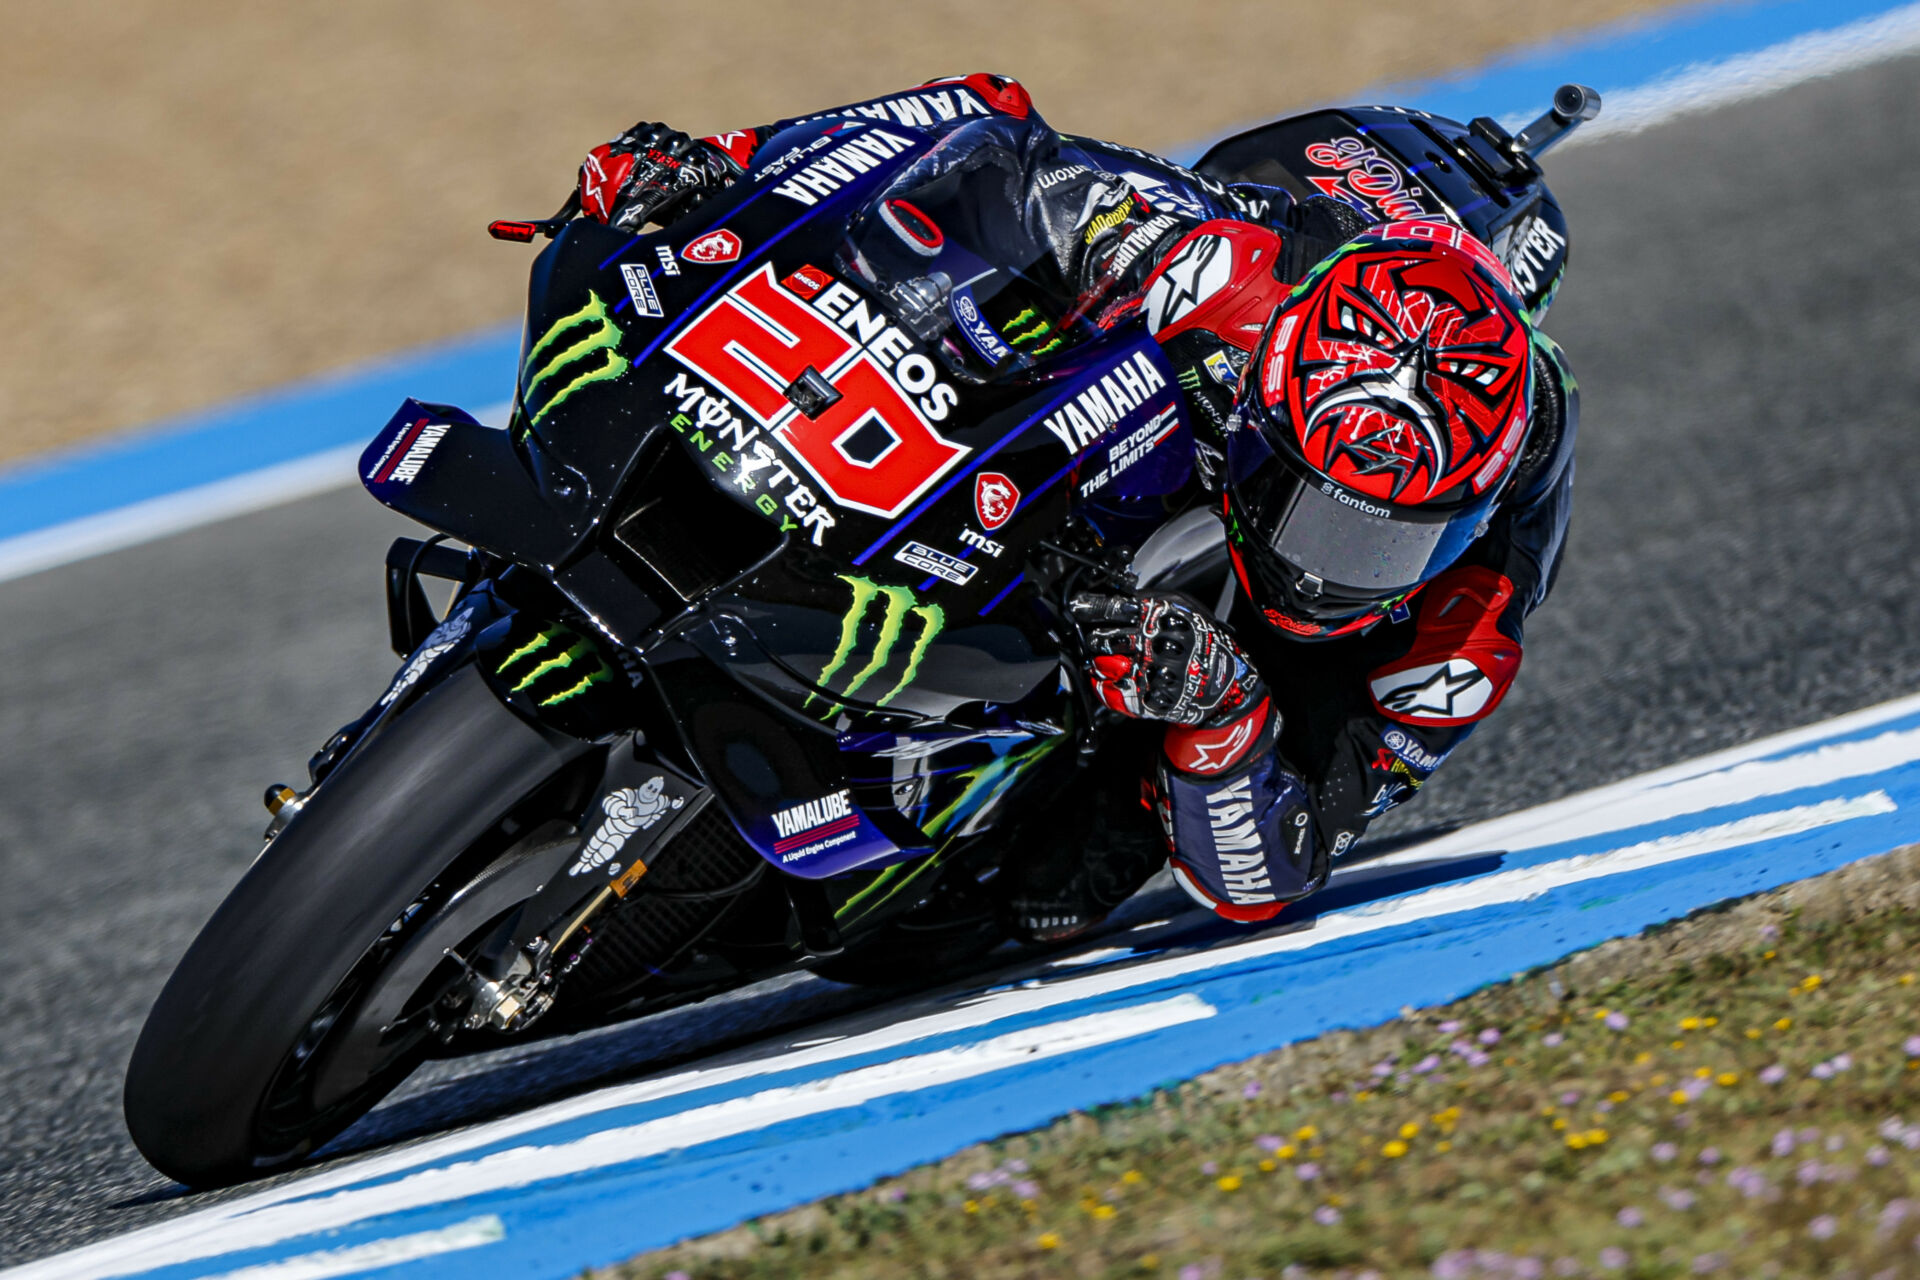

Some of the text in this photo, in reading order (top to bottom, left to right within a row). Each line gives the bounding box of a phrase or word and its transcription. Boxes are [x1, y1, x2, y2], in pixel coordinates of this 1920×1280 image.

[795, 89, 991, 127] YAMA
[754, 146, 802, 182] FAST
[772, 128, 916, 206] YAMAHA
[655, 245, 681, 275] msi
[794, 272, 821, 290] ENEOS
[624, 269, 646, 309] CORE
[635, 268, 659, 311] BLUE
[812, 281, 958, 421] ENEOS
[663, 261, 973, 519] 20
[1043, 350, 1167, 455] YAMAHA
[388, 424, 452, 485] YAMALUBE
[663, 373, 835, 546] MONSTER
[1109, 414, 1162, 463] BEYOND
[670, 413, 797, 533] ENERGY
[1080, 468, 1109, 498] THE
[1111, 436, 1155, 478] LIMITS
[1333, 488, 1391, 518] fantom
[911, 545, 971, 573] BLUE
[959, 528, 1005, 558] msi
[903, 555, 960, 581] CORE
[771, 788, 852, 838] YAMALUBE
[782, 831, 857, 864] A Liquid Engine Component
[1206, 776, 1276, 904] YAMAHA
